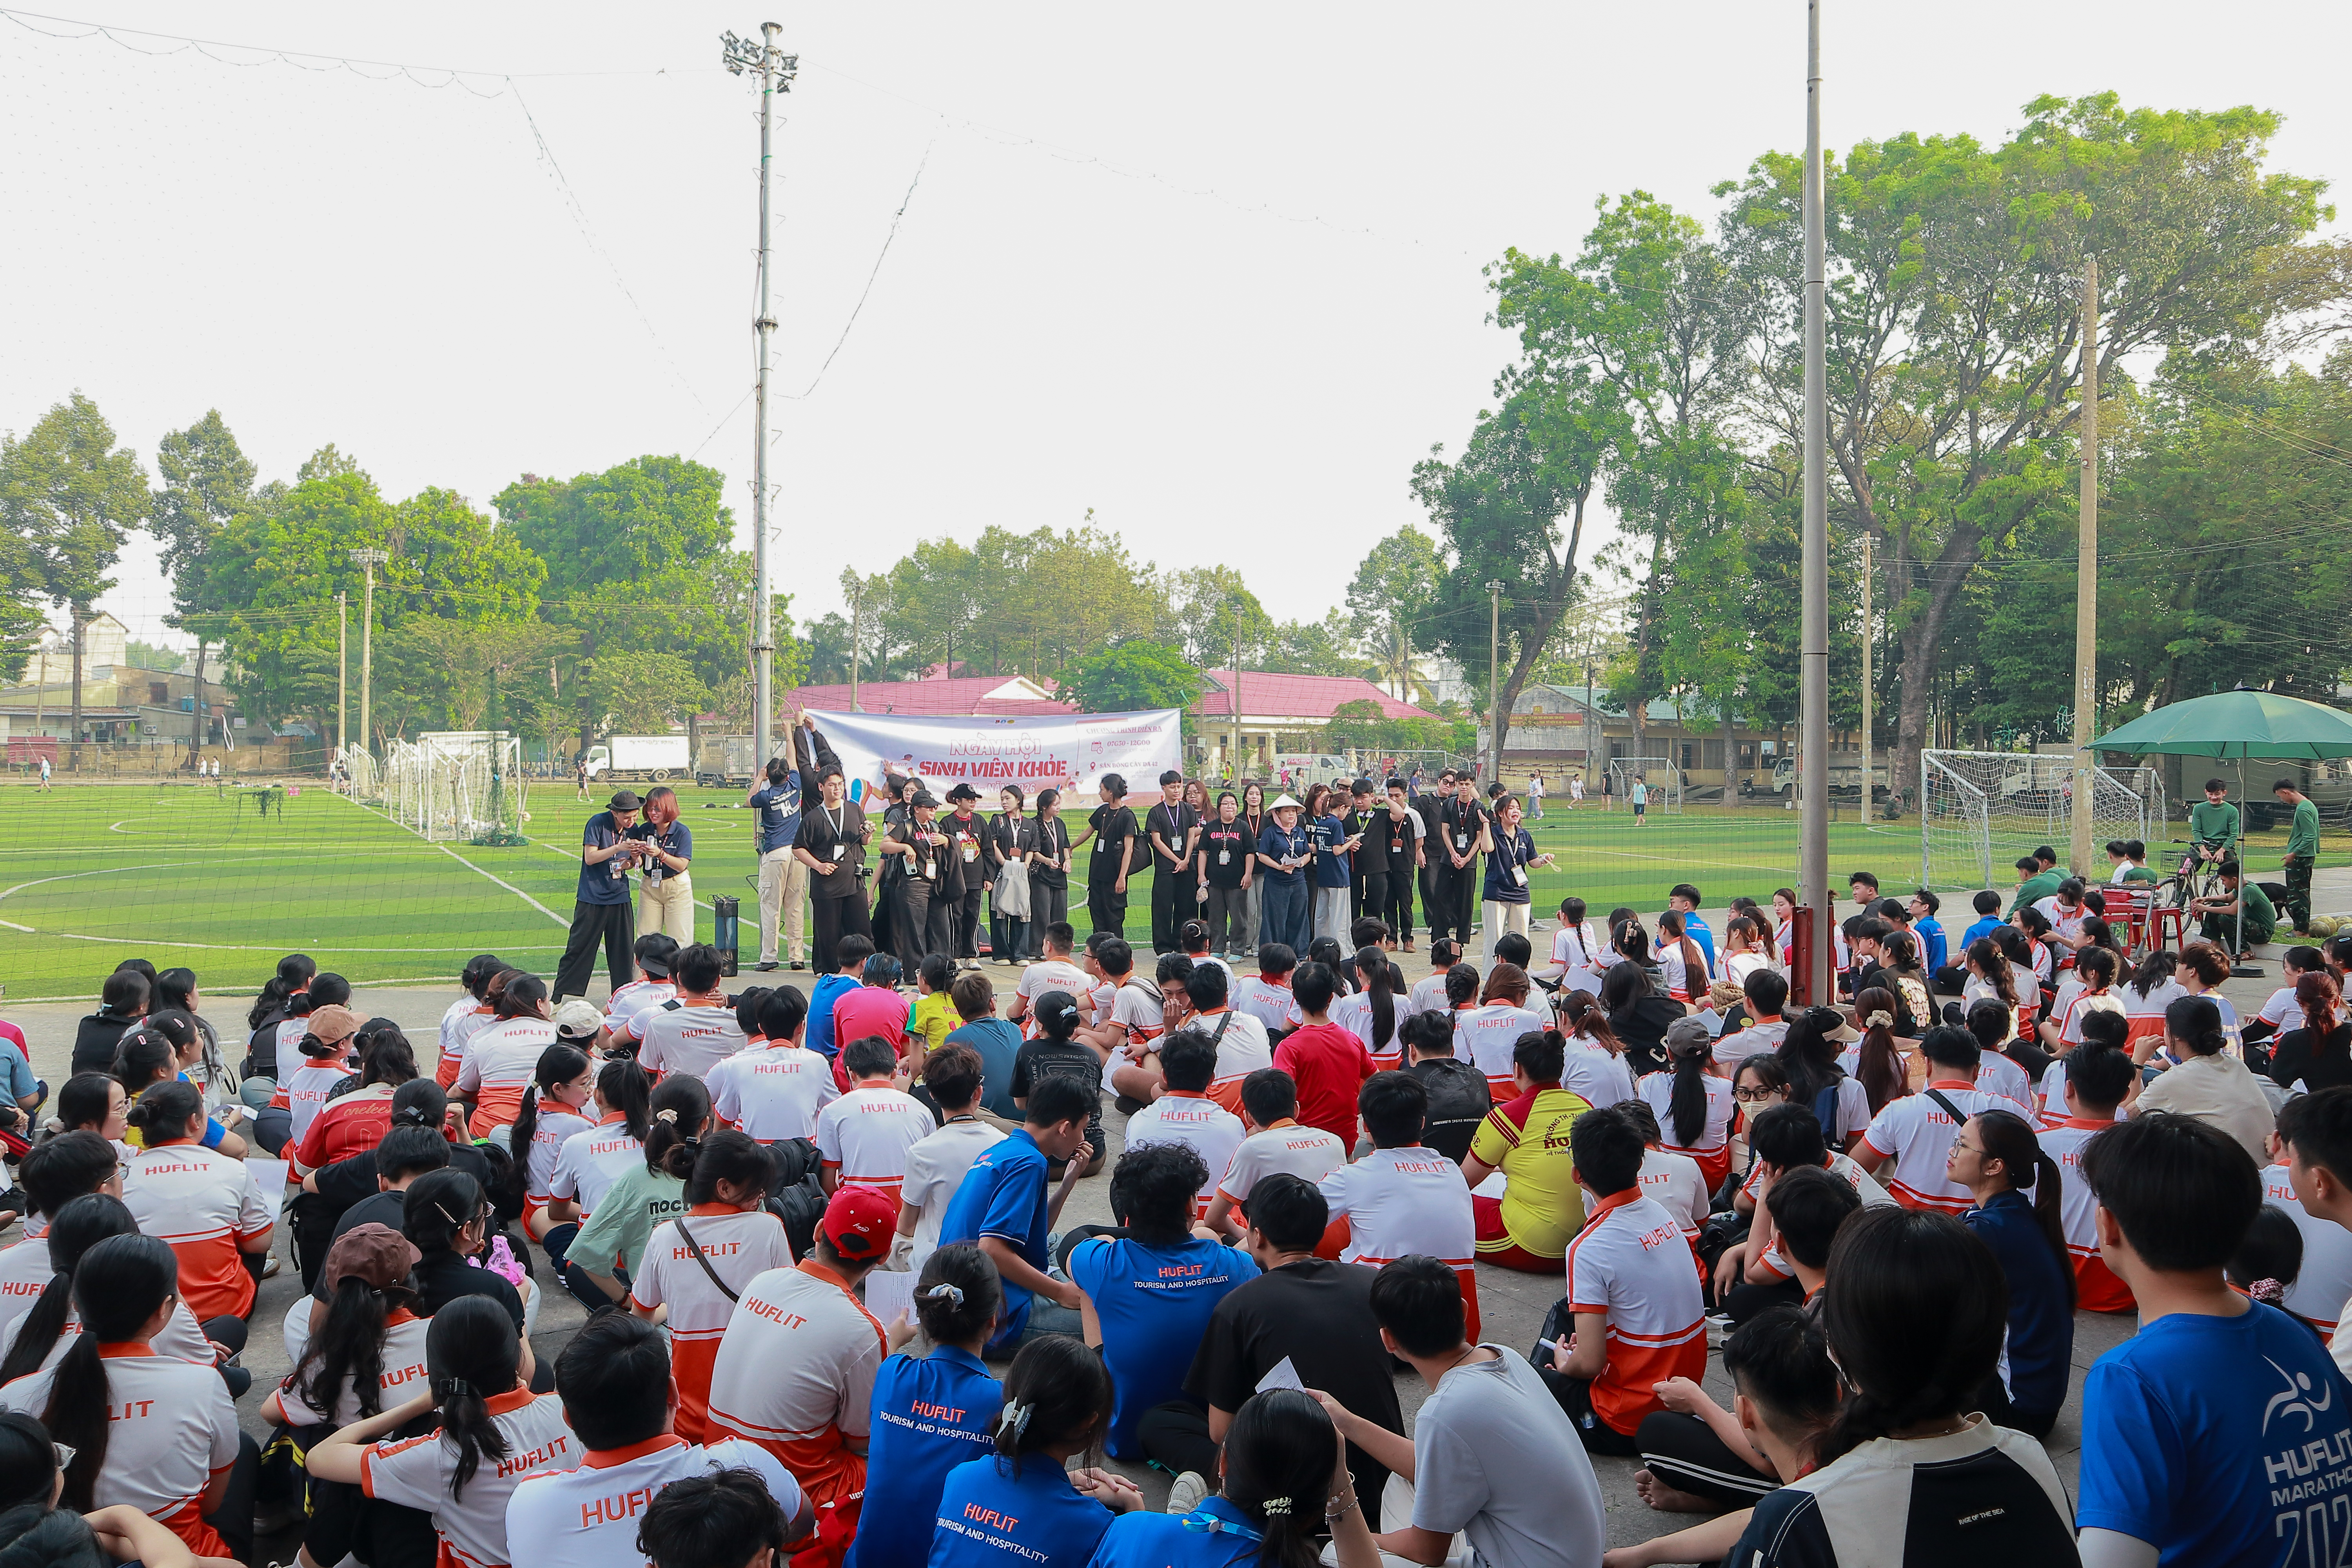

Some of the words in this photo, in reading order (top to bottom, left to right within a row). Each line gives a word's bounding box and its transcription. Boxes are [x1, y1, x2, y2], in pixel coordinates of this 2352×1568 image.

[949, 732, 1002, 755] NGÀY
[1005, 733, 1041, 760] HỘI
[919, 761, 967, 777] SINH
[971, 757, 1014, 777] VIÊN
[1018, 754, 1067, 777] KHỎE
[1210, 832, 1240, 840] ORINAL
[1047, 977, 1077, 987] HUFLIT
[1252, 993, 1284, 1008] HUFLIT
[942, 1006, 959, 1014] Phu
[1477, 1019, 1516, 1028] HUFLIT
[681, 1026, 723, 1038] HUFLIT
[281, 1035, 304, 1045] HUF
[754, 1063, 802, 1074] HUFLIT
[293, 1090, 328, 1102] HUFLIT
[860, 1103, 908, 1114] HUFLIT
[1160, 1112, 1211, 1122] HUFLIT
[532, 1131, 557, 1144] UFLIT
[1286, 1138, 1331, 1150] HUFLIT
[145, 1163, 210, 1176] HUFLIT
[1394, 1161, 1447, 1173] HUFLIT
[1636, 1174, 1671, 1185] FLIT
[1850, 1165, 1862, 1188] FLIT
[649, 1200, 692, 1215] noct
[1639, 1220, 1680, 1252] HUFLIT
[673, 1242, 741, 1260] HUFLIT
[1159, 1265, 1202, 1278] HUFLIT
[2, 1282, 45, 1297] HUF
[1133, 1281, 1166, 1289] TOURISM
[1185, 1275, 1229, 1287] HOSPITALITY
[744, 1296, 808, 1330] HUFLIT
[379, 1363, 429, 1390] UFL
[108, 1400, 155, 1422] LIT
[911, 1399, 965, 1423] HUFLIT
[879, 1411, 915, 1429] TOURISM
[916, 1421, 935, 1433] AND
[937, 1426, 996, 1445] HOSPITALITY
[497, 1436, 568, 1479] HUFLIT
[2263, 1428, 2352, 1484] HUFLIT
[2271, 1468, 2352, 1506] MARATHO
[581, 1487, 652, 1528] HUF
[1979, 1510, 1992, 1519] THE
[964, 1502, 1019, 1533] HUFLIT
[2276, 1494, 2352, 1568] 202
[937, 1517, 965, 1534] TOURISM
[965, 1527, 985, 1541] AND
[985, 1534, 1049, 1564] HOSPITALITY
